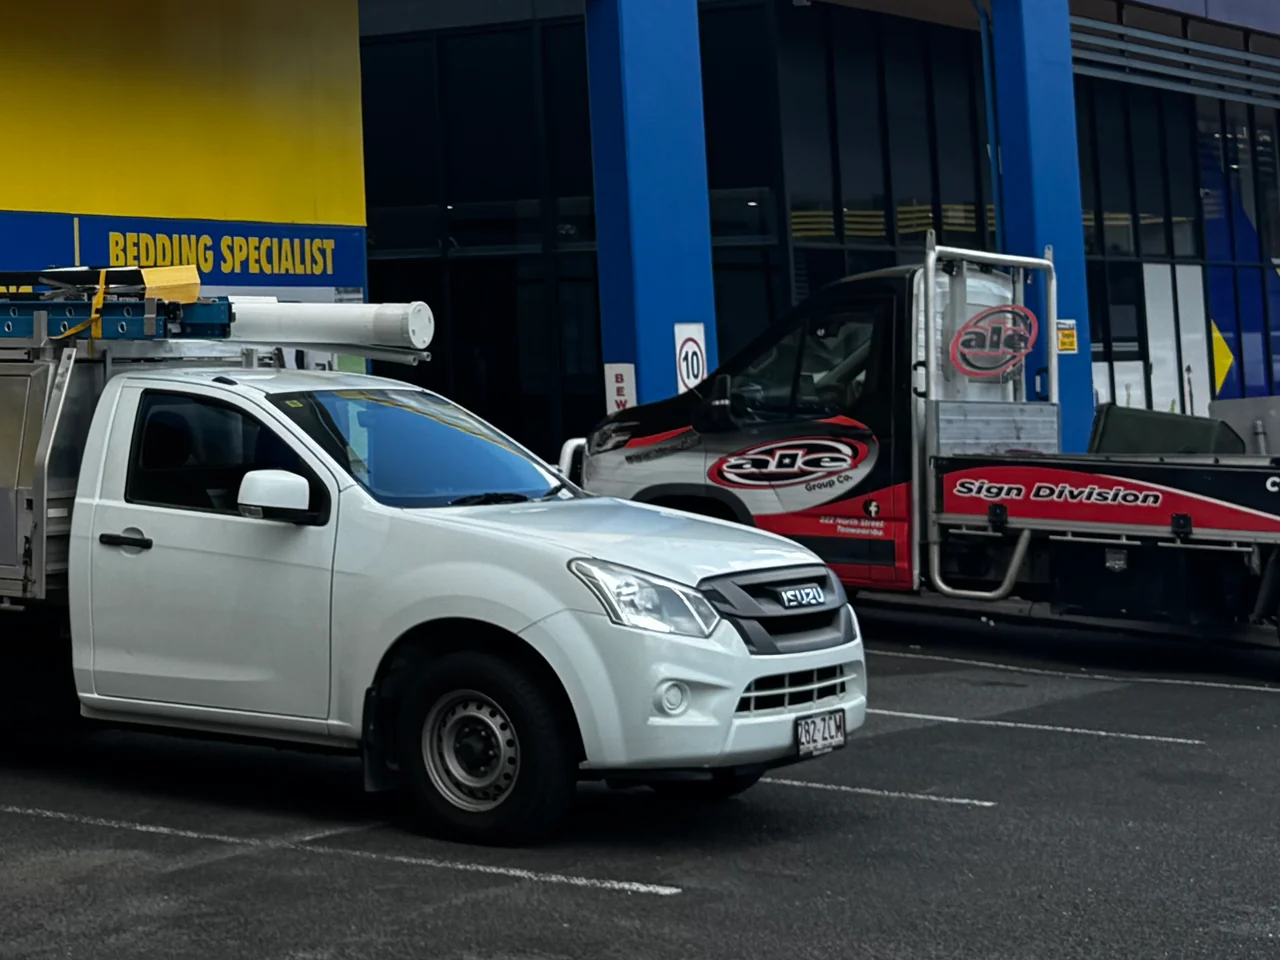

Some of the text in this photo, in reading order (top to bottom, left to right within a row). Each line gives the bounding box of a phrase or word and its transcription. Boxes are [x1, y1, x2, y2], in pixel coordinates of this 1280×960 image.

[108, 231, 335, 275] BEDDING SPECIALIST
[682, 350, 701, 380] 10
[805, 477, 835, 492] Group
[954, 479, 1162, 506] Sign Division
[781, 586, 824, 607] ISUZU
